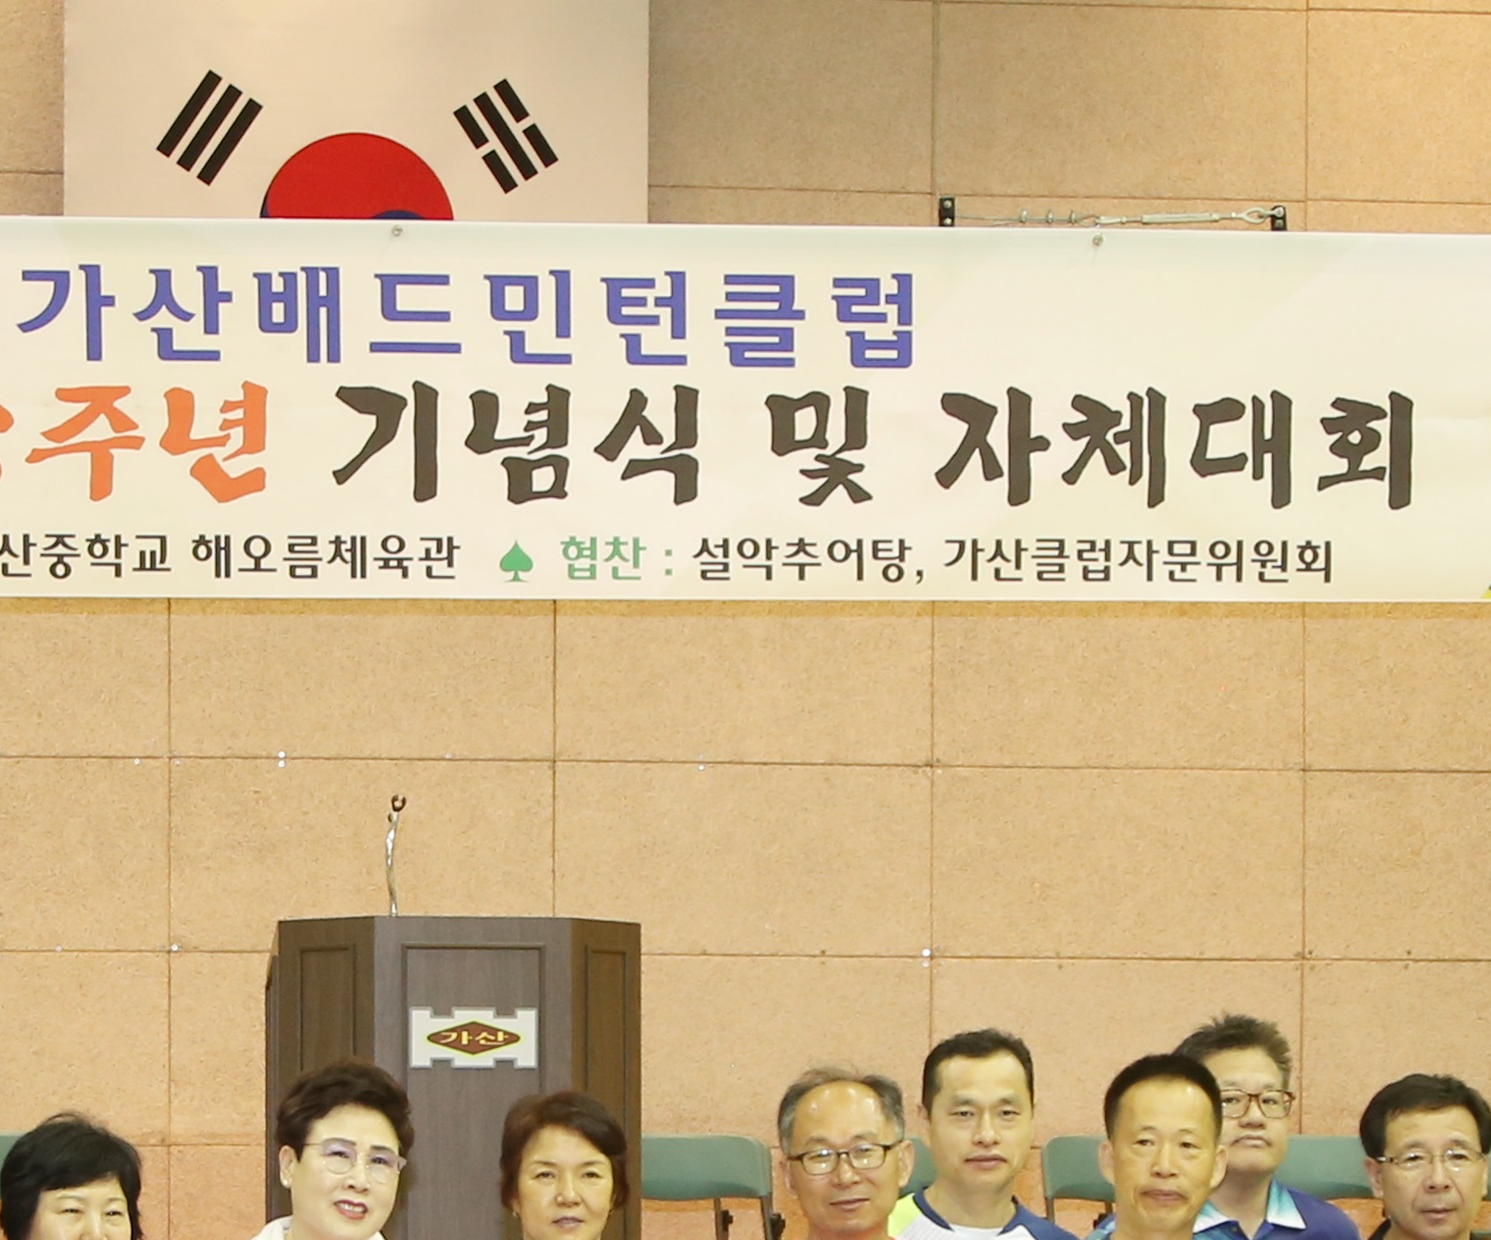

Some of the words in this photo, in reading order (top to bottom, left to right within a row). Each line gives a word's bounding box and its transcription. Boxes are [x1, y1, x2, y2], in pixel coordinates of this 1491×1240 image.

[17, 264, 913, 368] 가산배드민턴클럽
[333, 381, 700, 506] 기념식
[764, 386, 875, 507] 및
[935, 387, 1414, 510] 자체대회
[191, 534, 461, 580] 해오름체육관
[562, 536, 645, 581] 협찬
[692, 537, 924, 584] 설악추어탕,
[944, 538, 1332, 584] 가산클럽자문위원회
[439, 1030, 509, 1046] 가산
